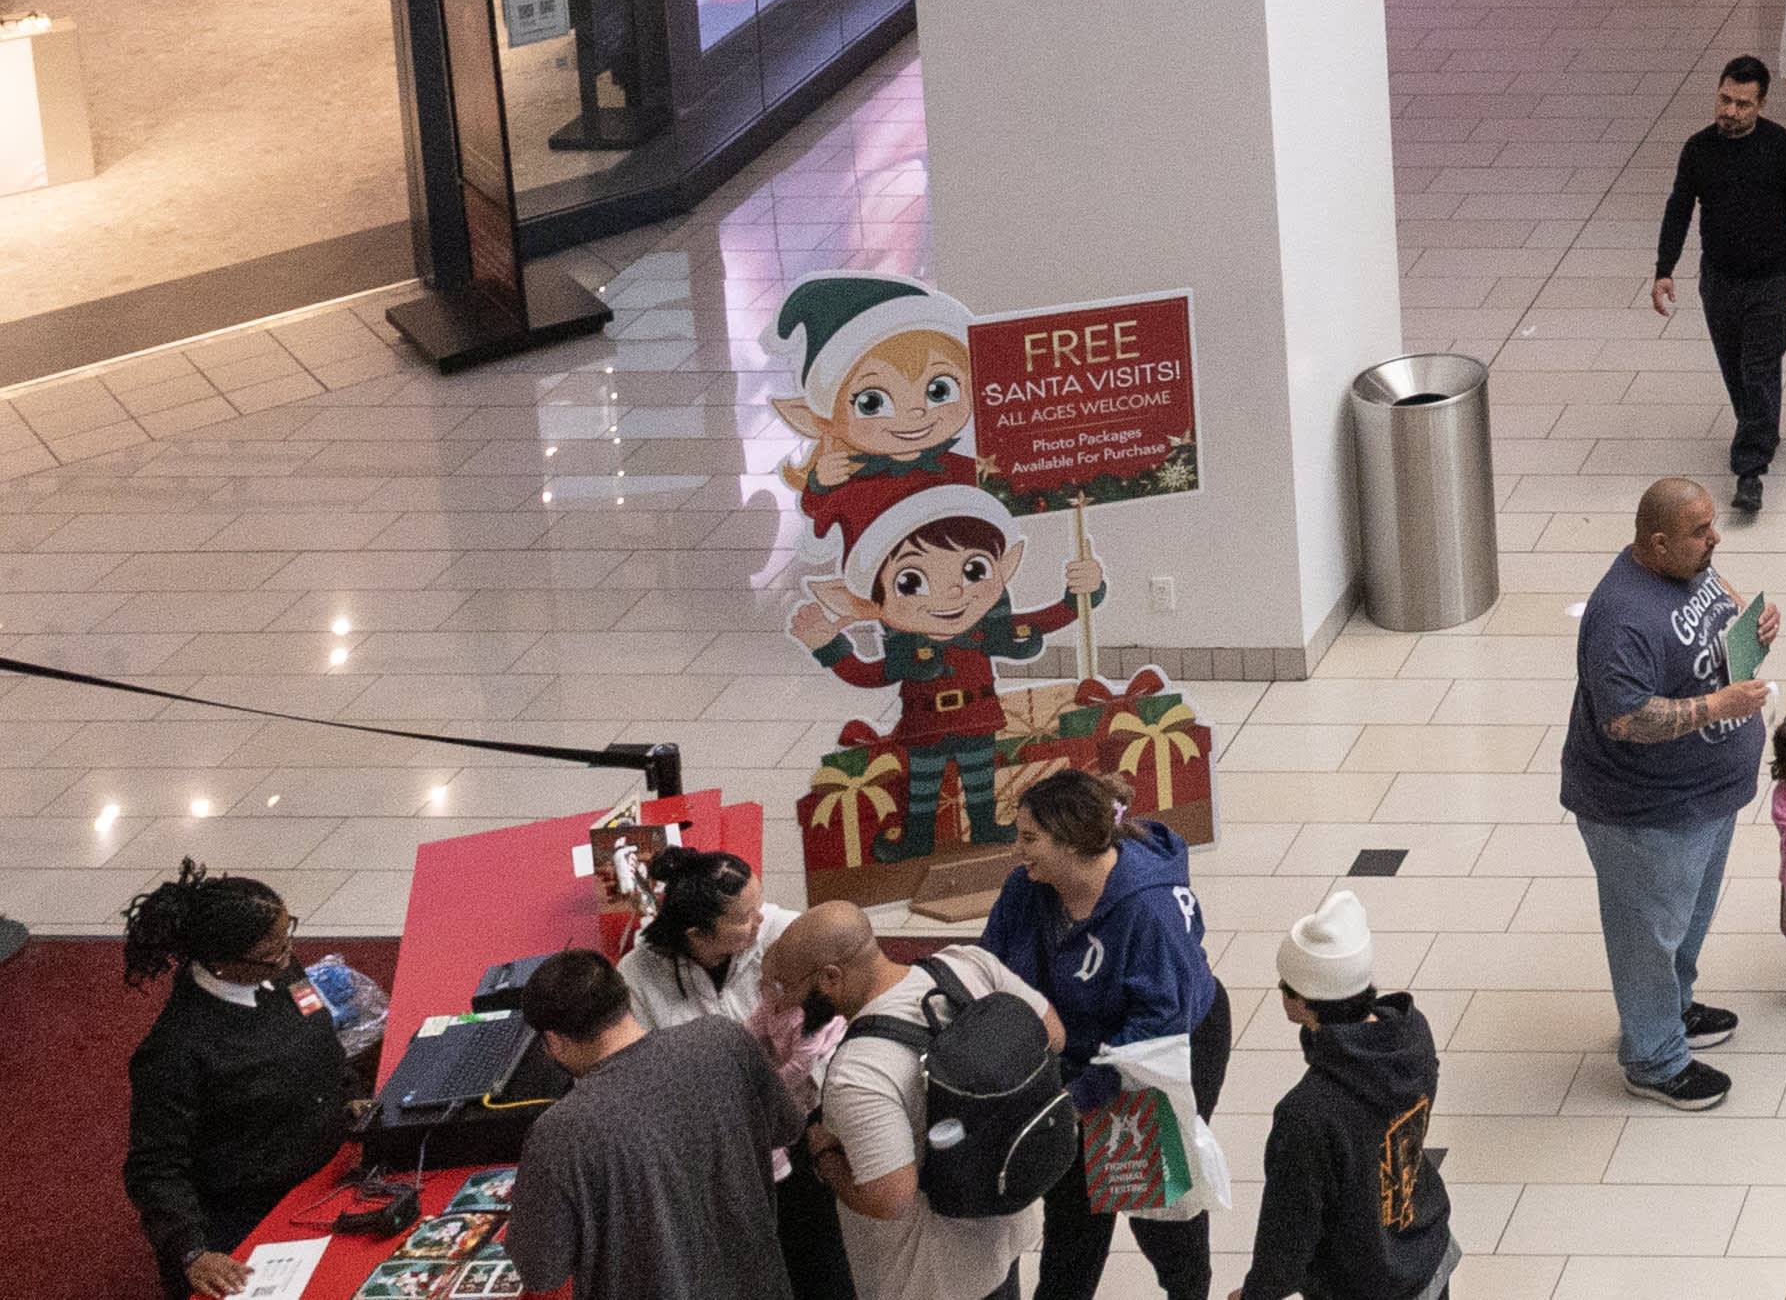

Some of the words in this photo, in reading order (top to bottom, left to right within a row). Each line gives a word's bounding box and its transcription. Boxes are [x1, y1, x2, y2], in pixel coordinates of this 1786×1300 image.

[1023, 319, 1141, 373] FREE
[984, 374, 1084, 408] SANTA
[1086, 359, 1182, 393] VISITS!
[996, 413, 1026, 428] ALL
[1030, 403, 1078, 423] AGES
[1079, 390, 1172, 416] WELCOME
[1011, 454, 1074, 474] Available
[1077, 451, 1100, 465] For
[1103, 442, 1167, 462] Purchase
[1032, 436, 1075, 453] Photo
[1078, 428, 1143, 448] Packages
